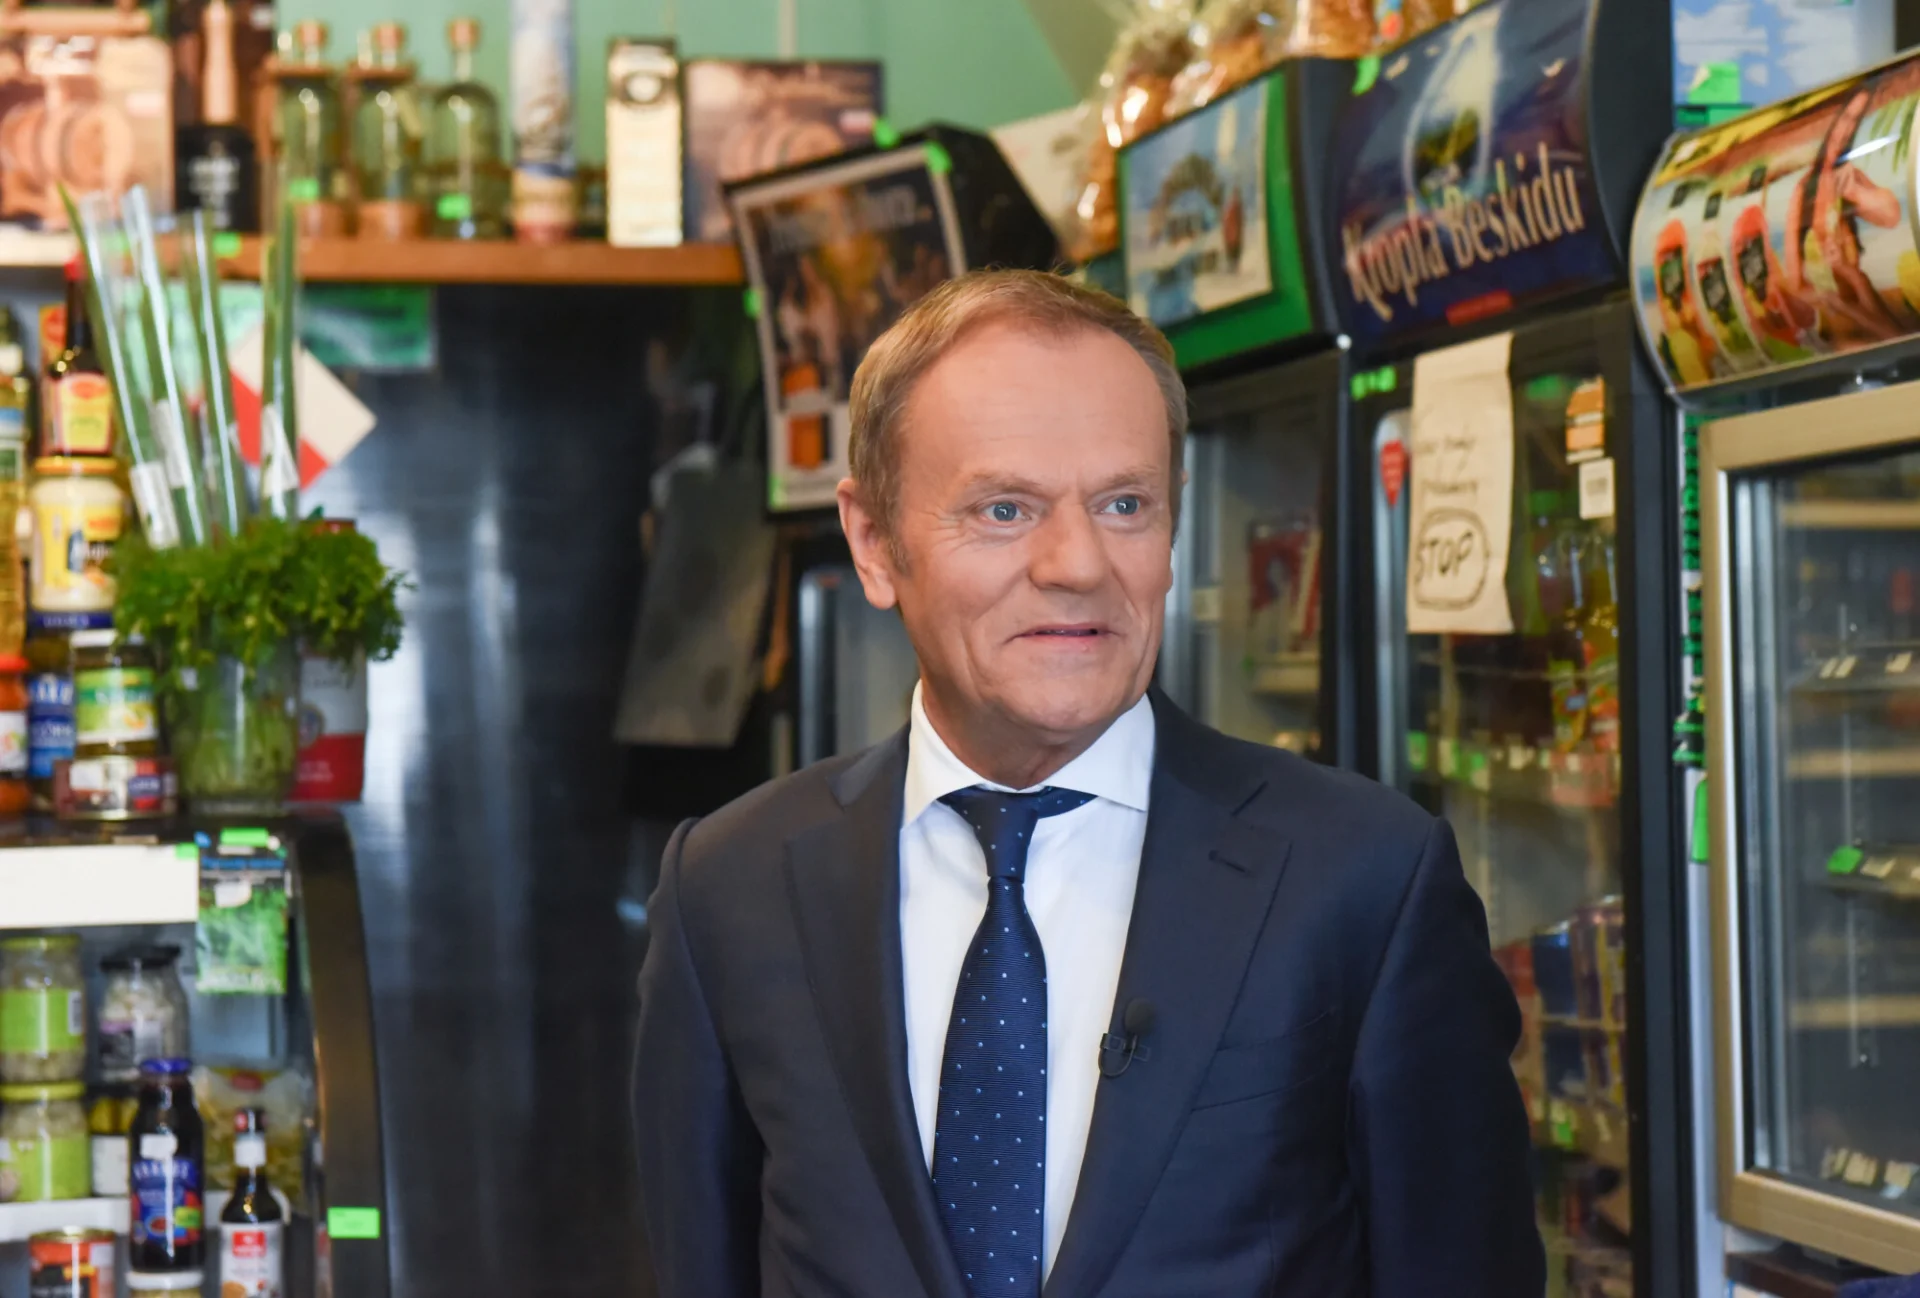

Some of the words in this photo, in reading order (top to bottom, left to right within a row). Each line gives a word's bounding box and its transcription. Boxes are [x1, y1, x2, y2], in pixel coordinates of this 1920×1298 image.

[1342, 193, 1449, 322] Kropla
[1438, 141, 1585, 269] Beskidu
[1415, 529, 1474, 584] STOP
